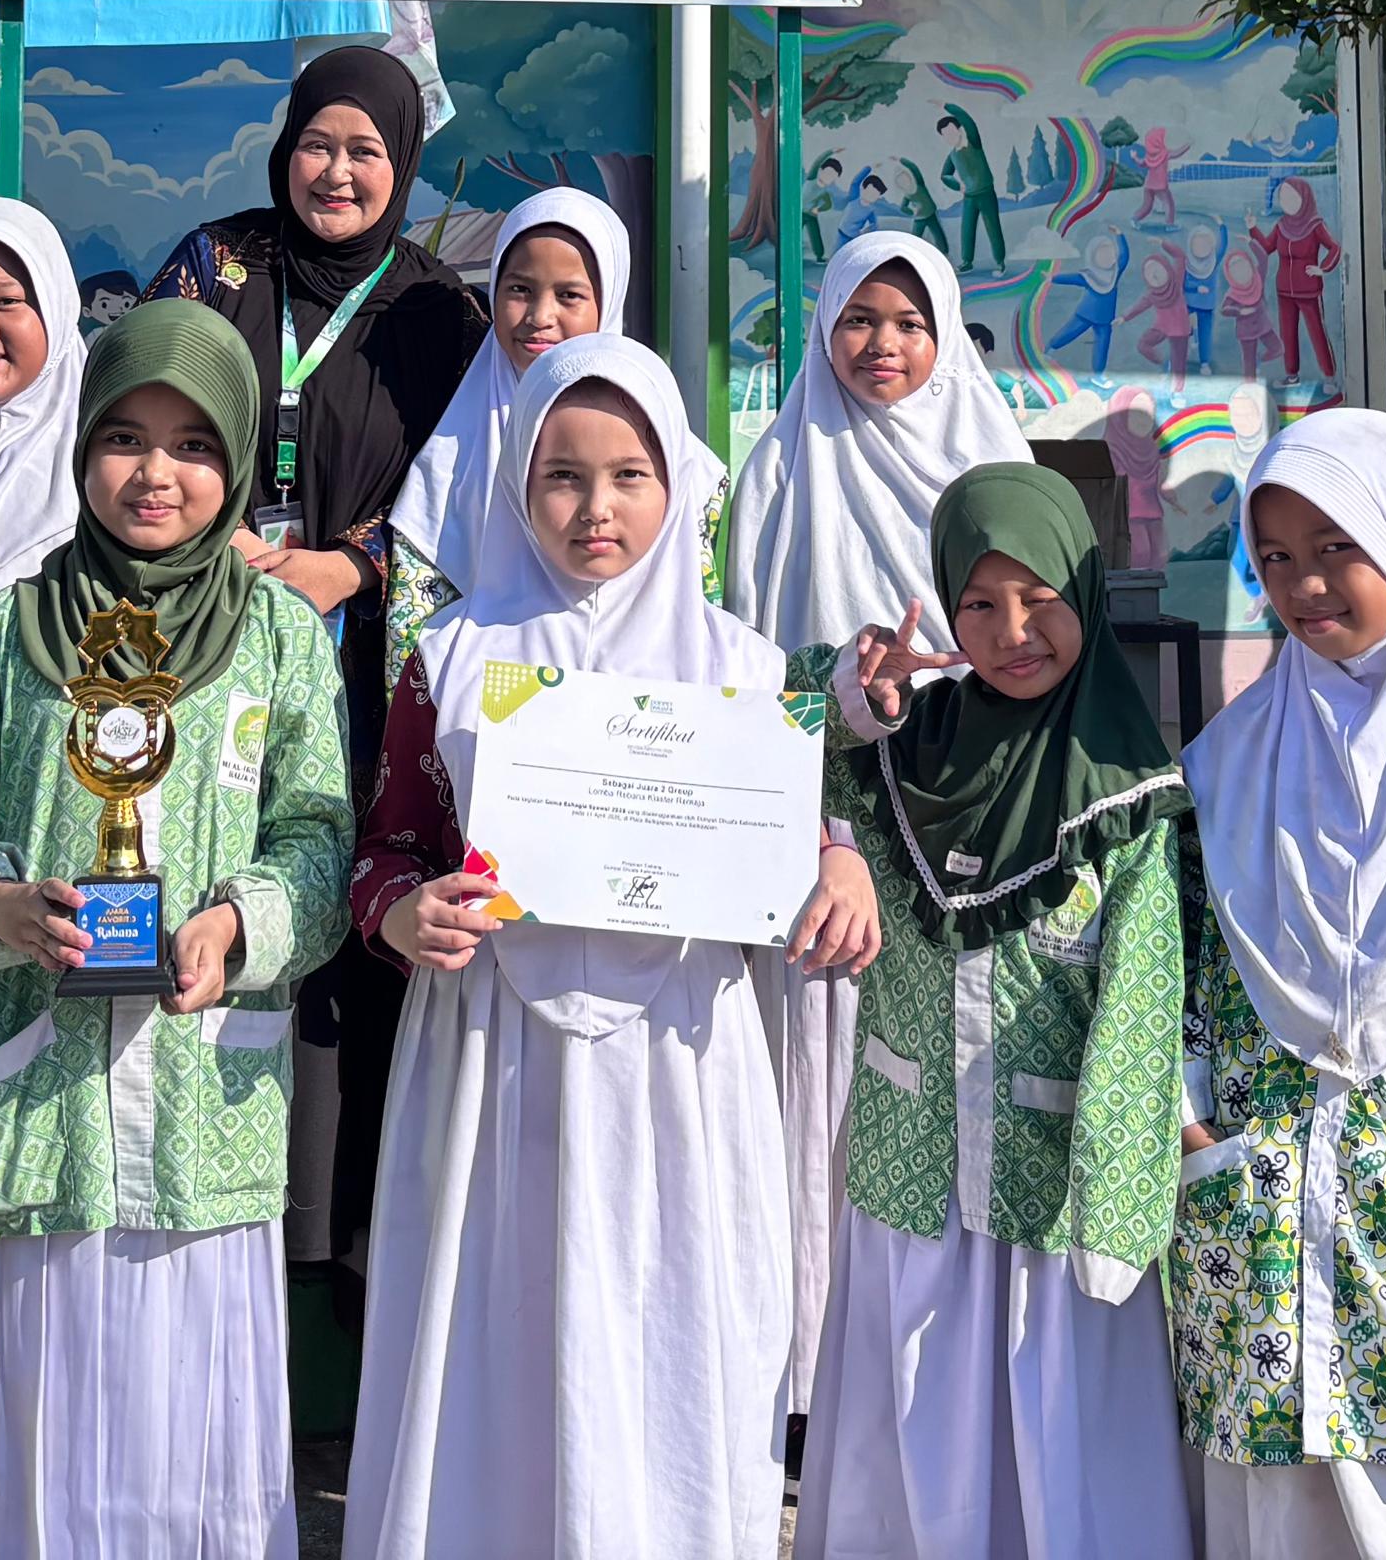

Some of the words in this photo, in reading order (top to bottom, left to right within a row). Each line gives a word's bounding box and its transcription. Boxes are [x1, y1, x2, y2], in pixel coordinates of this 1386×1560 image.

[606, 713, 695, 746] Sertifikat
[602, 778, 634, 791] Sebagai
[636, 783, 659, 793] Juara
[1264, 1094, 1287, 1107] DDI
[1260, 1269, 1284, 1283] DDI
[1264, 1450, 1290, 1462] DDI
